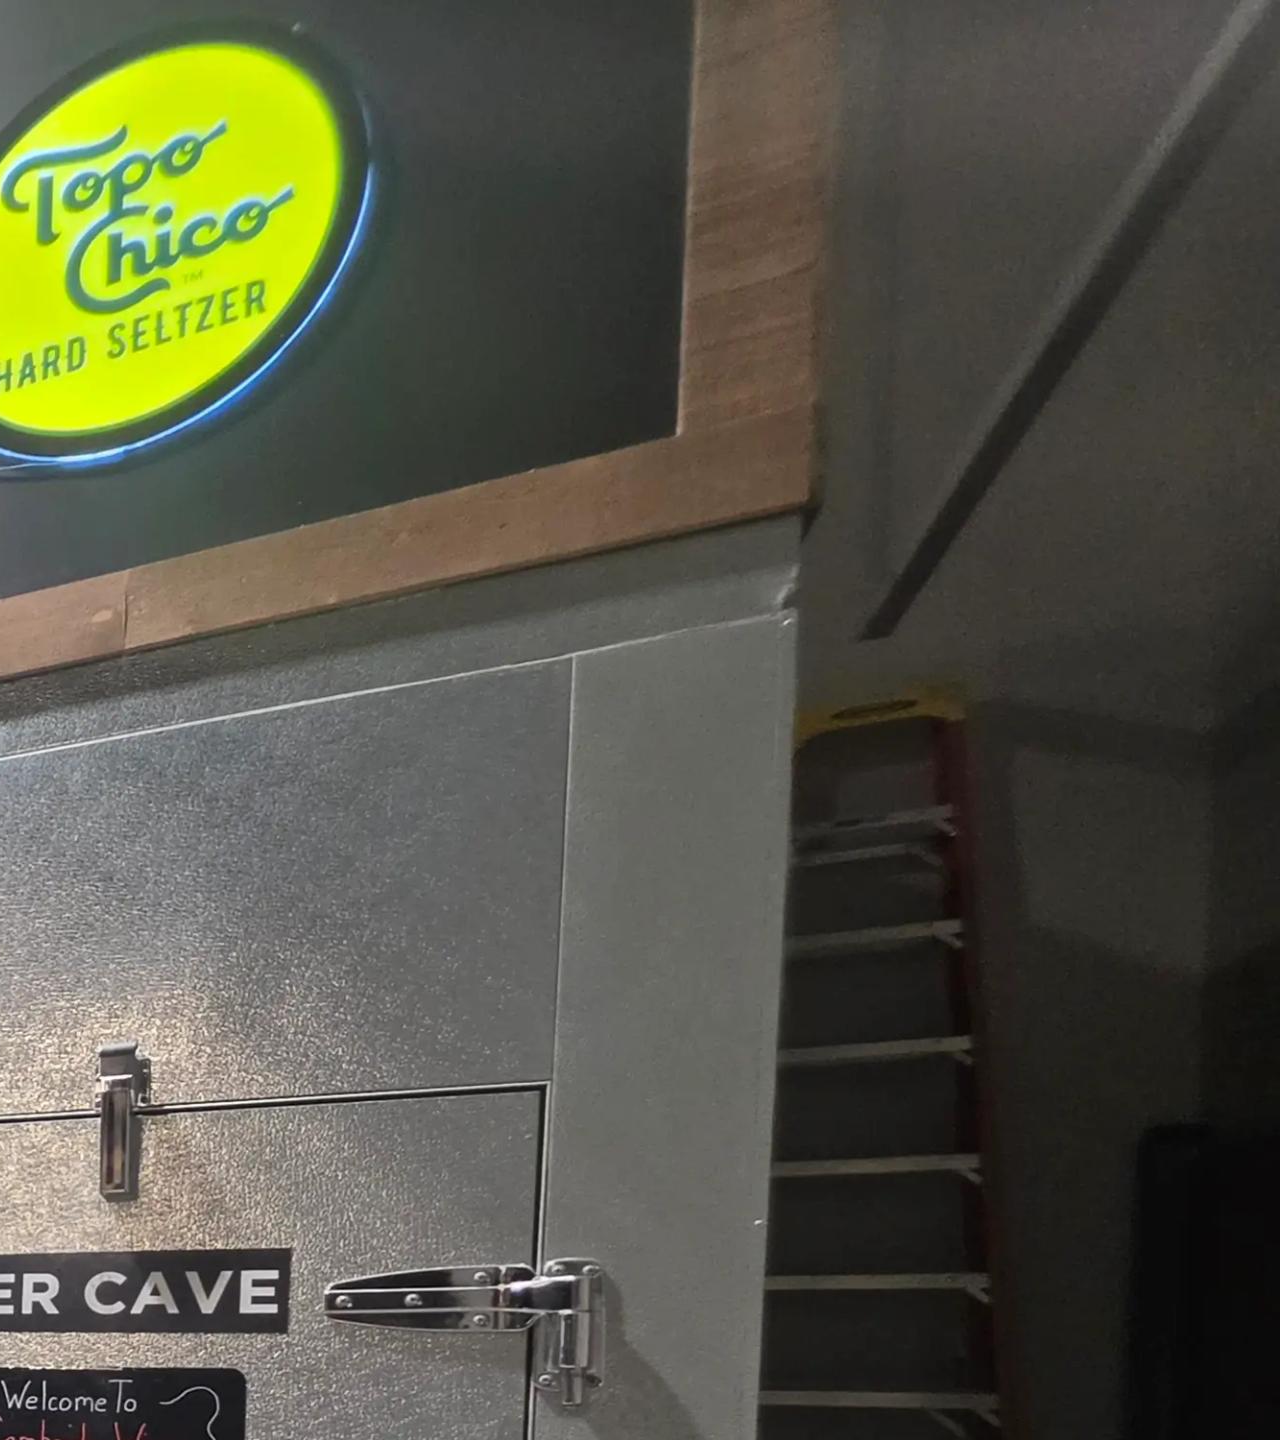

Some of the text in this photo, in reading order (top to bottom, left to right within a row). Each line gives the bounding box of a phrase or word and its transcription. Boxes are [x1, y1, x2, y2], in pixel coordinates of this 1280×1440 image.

[1, 119, 227, 244] Topo
[67, 188, 294, 313] Chico
[107, 281, 267, 360] SELTZER
[83, 1269, 281, 1315] CAVE
[0, 1379, 138, 1413] Welcome To
